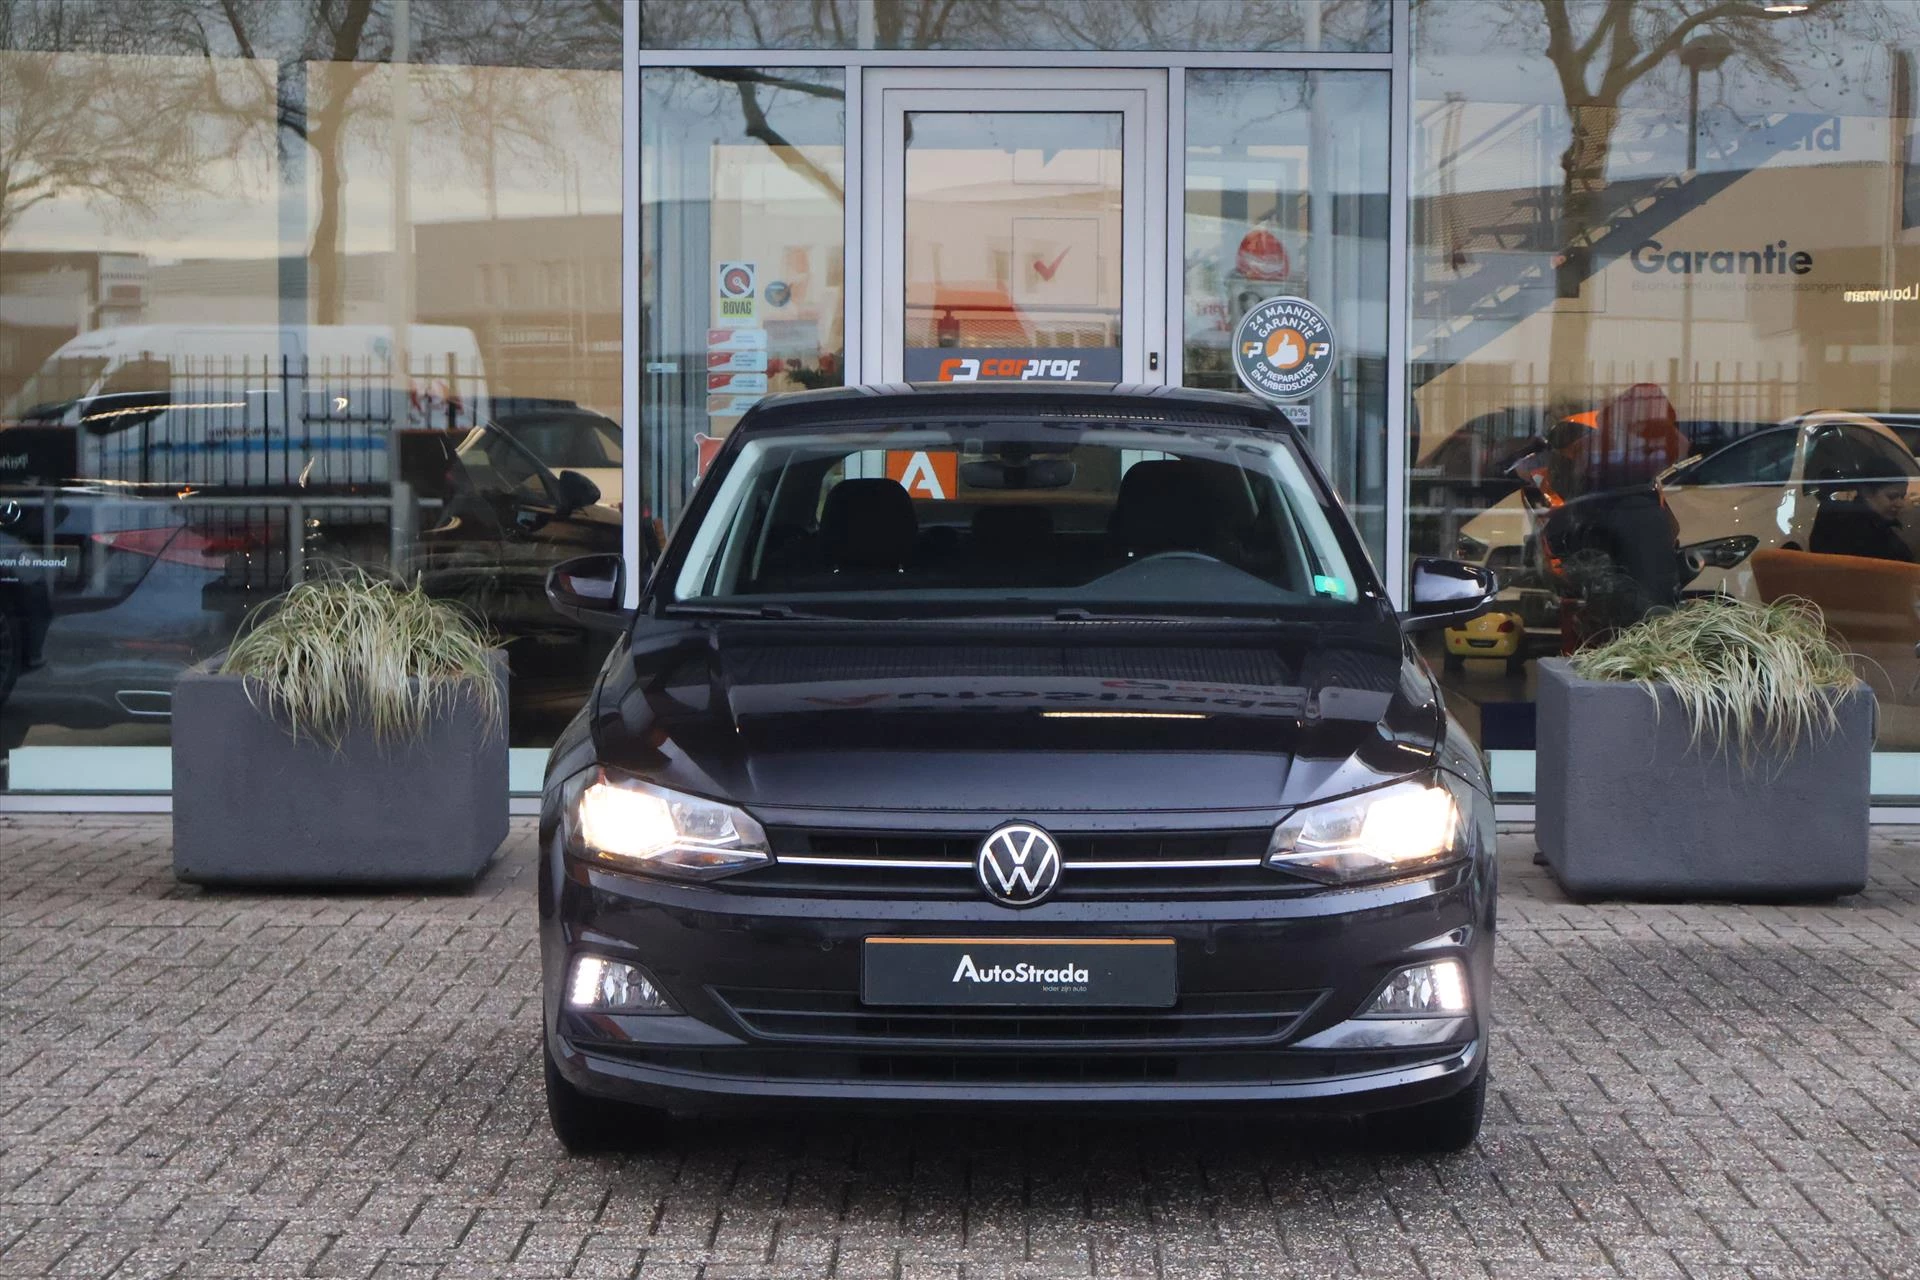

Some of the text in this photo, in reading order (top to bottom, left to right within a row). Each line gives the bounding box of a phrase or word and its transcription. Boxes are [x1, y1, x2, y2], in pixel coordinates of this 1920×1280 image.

[1630, 239, 1813, 275] Garantie
[723, 301, 752, 315] BOVAG
[1249, 305, 1325, 333] 24 MAANDEN
[1258, 316, 1315, 340] GARANTIE
[1250, 368, 1319, 392] EN ARBEIDSLOON
[1256, 361, 1315, 383] OP REPARATIES
[900, 451, 946, 500] A
[0, 556, 68, 567] van de maand
[952, 954, 1089, 983] AutoStrada
